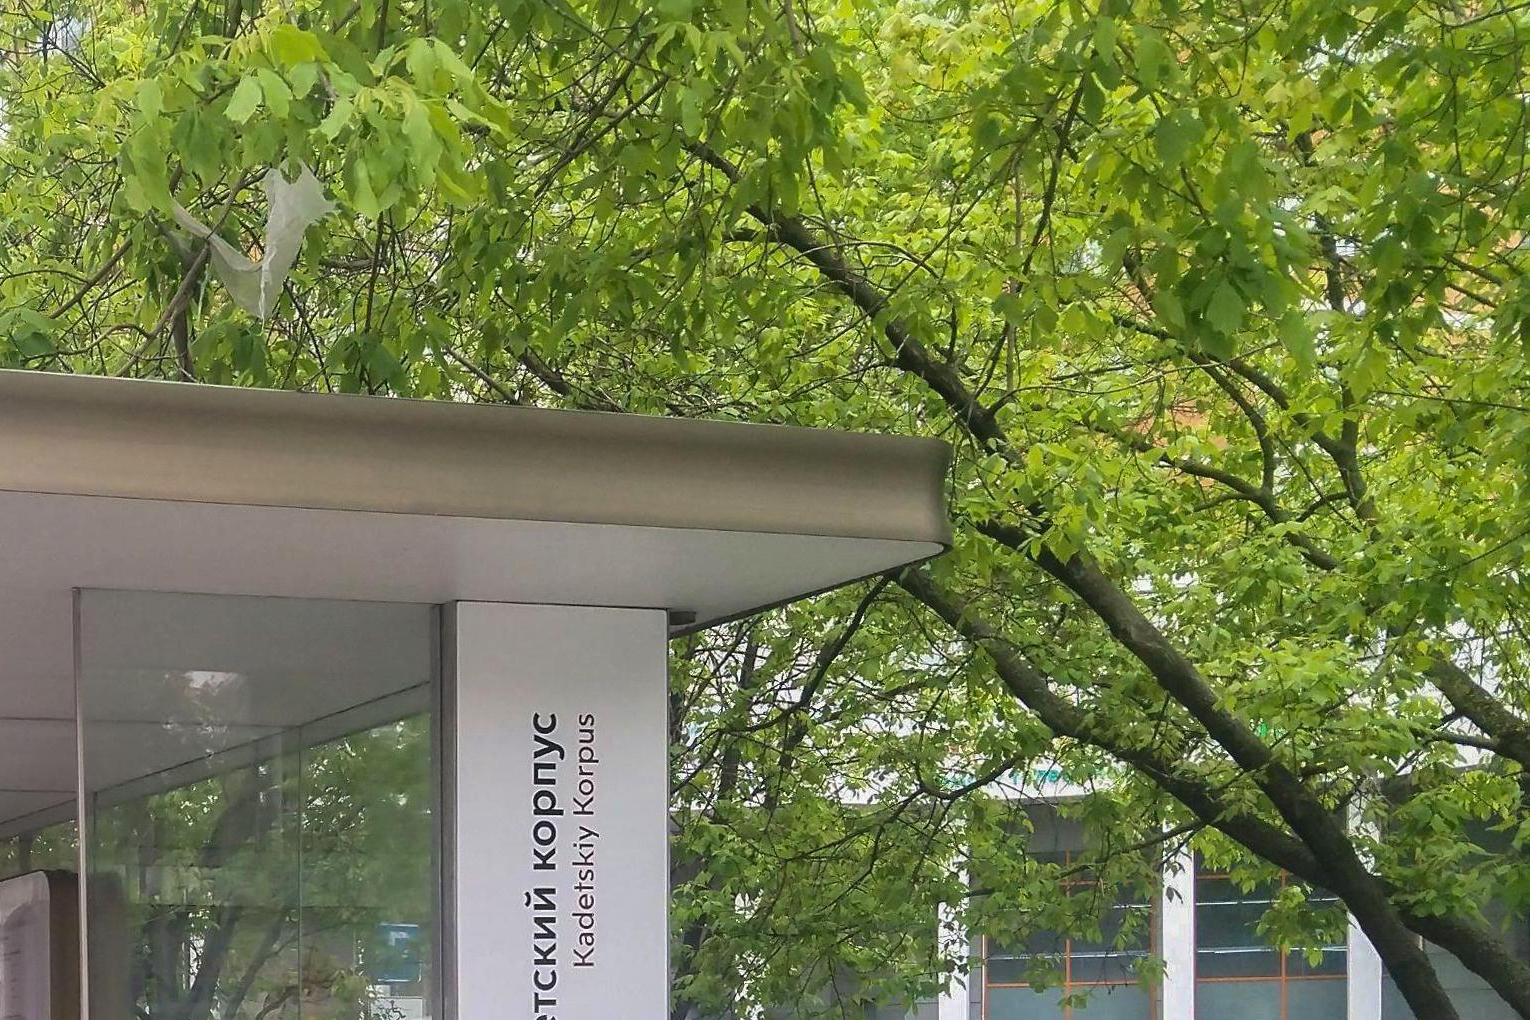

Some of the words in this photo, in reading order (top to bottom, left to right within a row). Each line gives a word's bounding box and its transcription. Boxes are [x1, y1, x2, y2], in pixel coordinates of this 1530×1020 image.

[532, 712, 565, 870] корпус
[572, 713, 600, 815] Korpus
[572, 826, 600, 967] Kadetskiy
